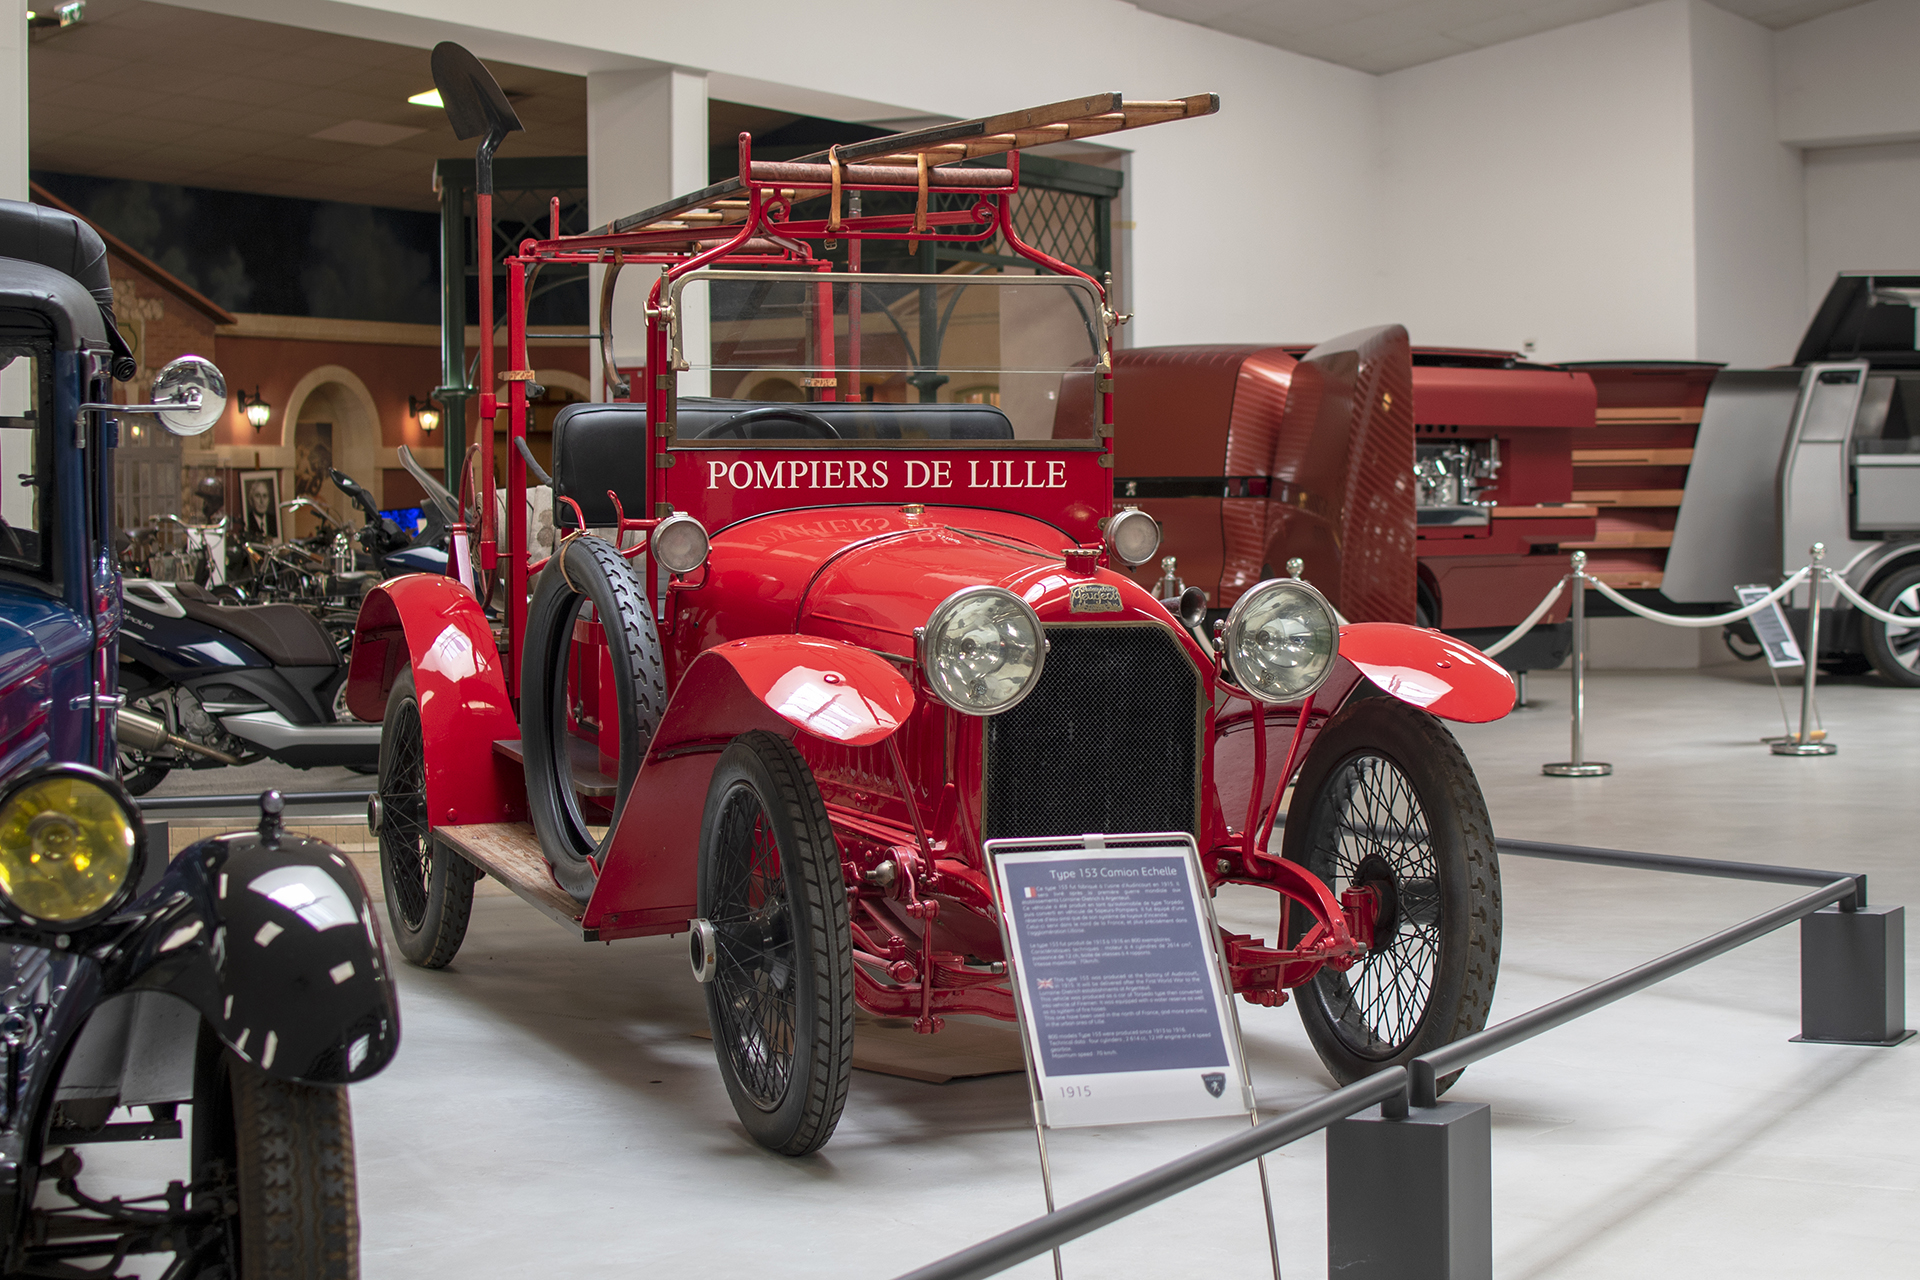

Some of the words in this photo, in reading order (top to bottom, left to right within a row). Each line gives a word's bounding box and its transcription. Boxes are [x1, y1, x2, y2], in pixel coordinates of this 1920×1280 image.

[707, 461, 889, 489] POMPIERS
[904, 461, 953, 488] DE
[968, 461, 1067, 488] LILLE
[1049, 869, 1076, 881] Type
[1079, 868, 1098, 878] 153
[1100, 867, 1139, 878] Camion
[1141, 866, 1177, 877] Echelle
[1060, 1085, 1092, 1098] 1915
